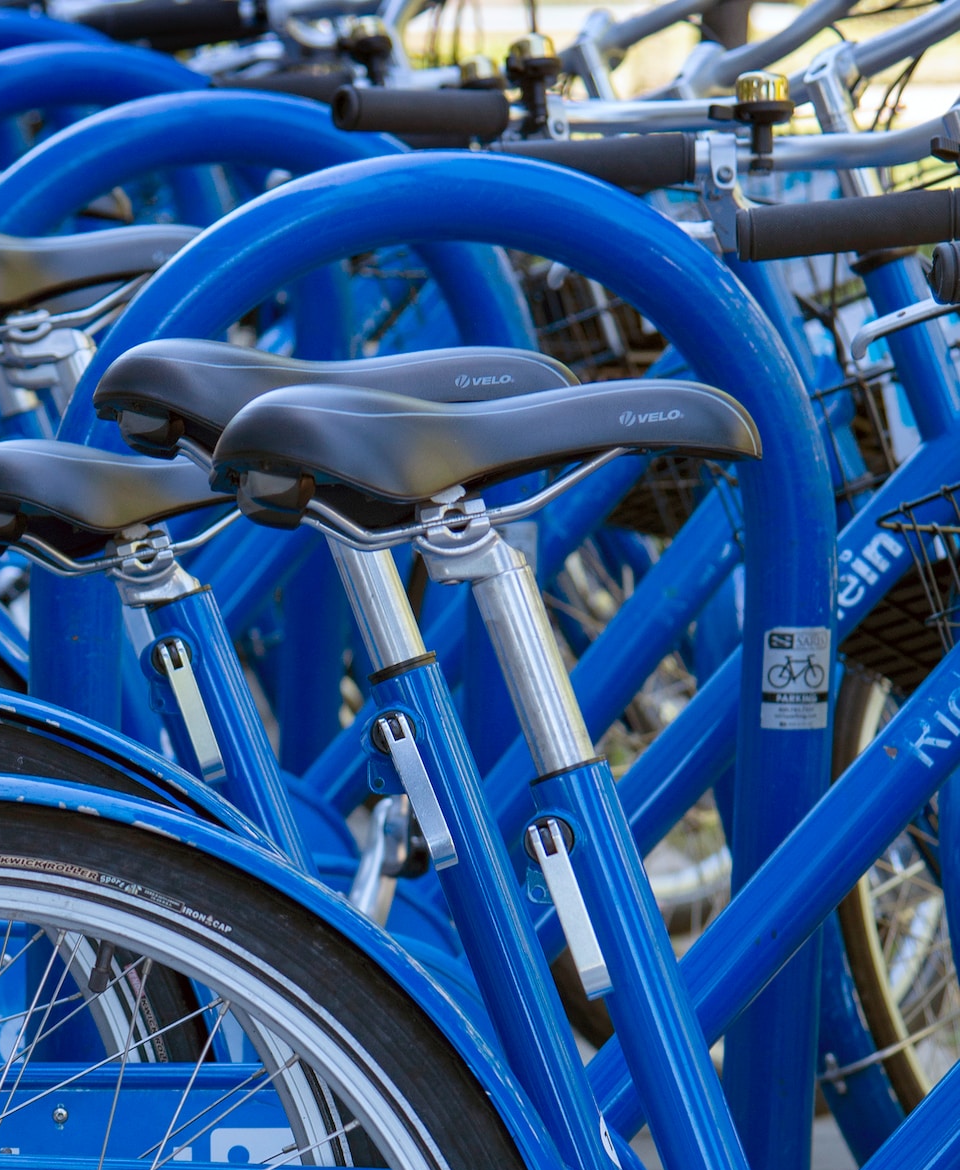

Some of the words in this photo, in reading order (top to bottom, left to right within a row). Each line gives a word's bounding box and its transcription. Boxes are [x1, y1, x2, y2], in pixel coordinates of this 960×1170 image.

[472, 374, 512, 387] VELO
[637, 409, 681, 424] VELO
[182, 905, 208, 923] IRON
[212, 919, 233, 934] CAP
